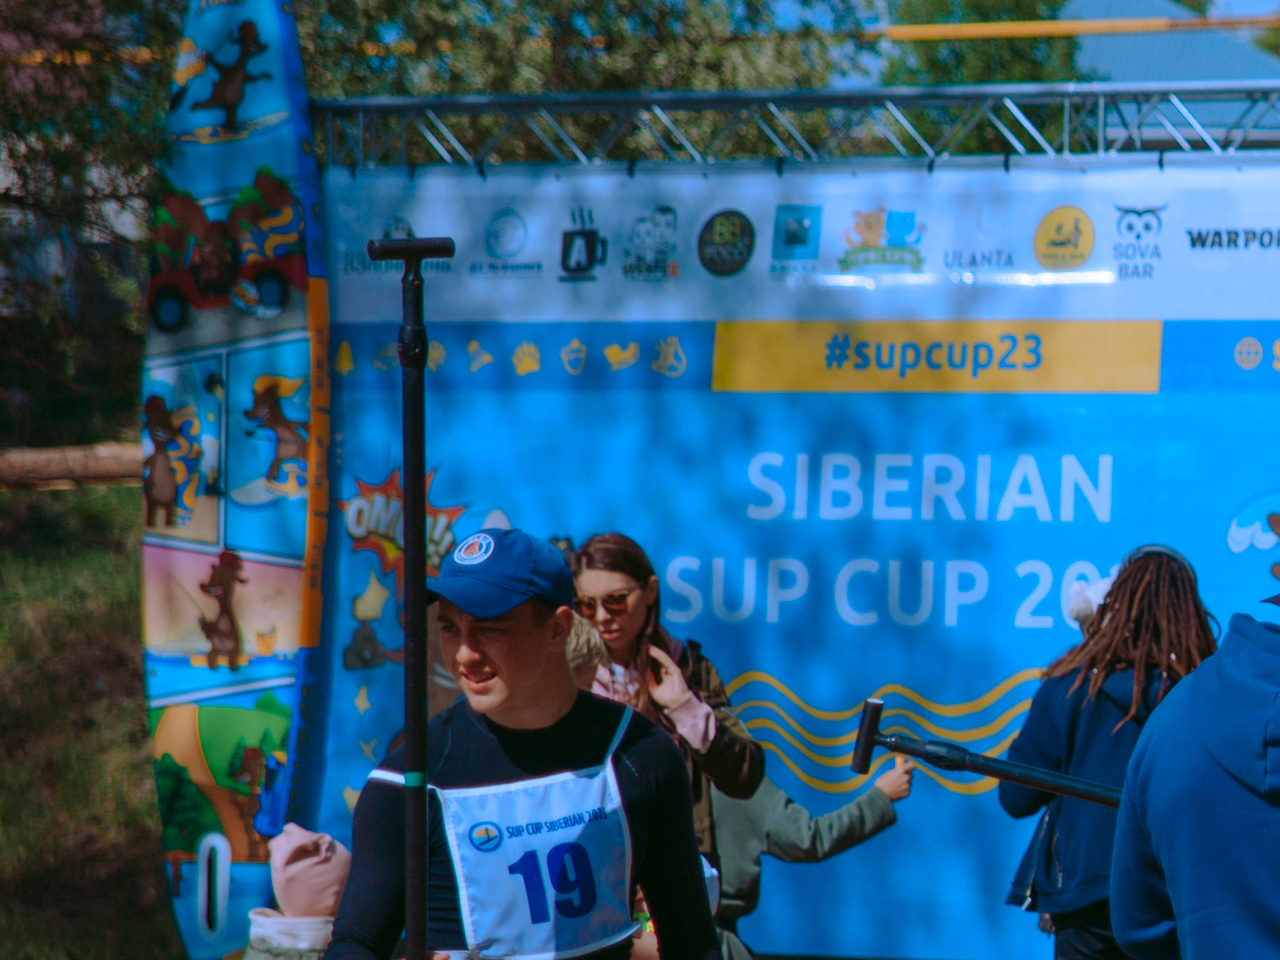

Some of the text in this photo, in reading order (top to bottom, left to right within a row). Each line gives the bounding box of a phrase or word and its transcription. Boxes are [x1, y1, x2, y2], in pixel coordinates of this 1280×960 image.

[943, 251, 1015, 269] ULANTA
[1113, 243, 1162, 262] SOVA
[1118, 262, 1155, 281] BAR
[825, 333, 1043, 379] #supcup23
[746, 451, 1114, 523] SIBERIAN
[664, 555, 1121, 631] SUP CUP 20
[506, 826, 524, 838] SUP
[526, 822, 543, 835] CUP
[545, 813, 586, 832] SIBERIAN
[507, 841, 598, 925] 19
